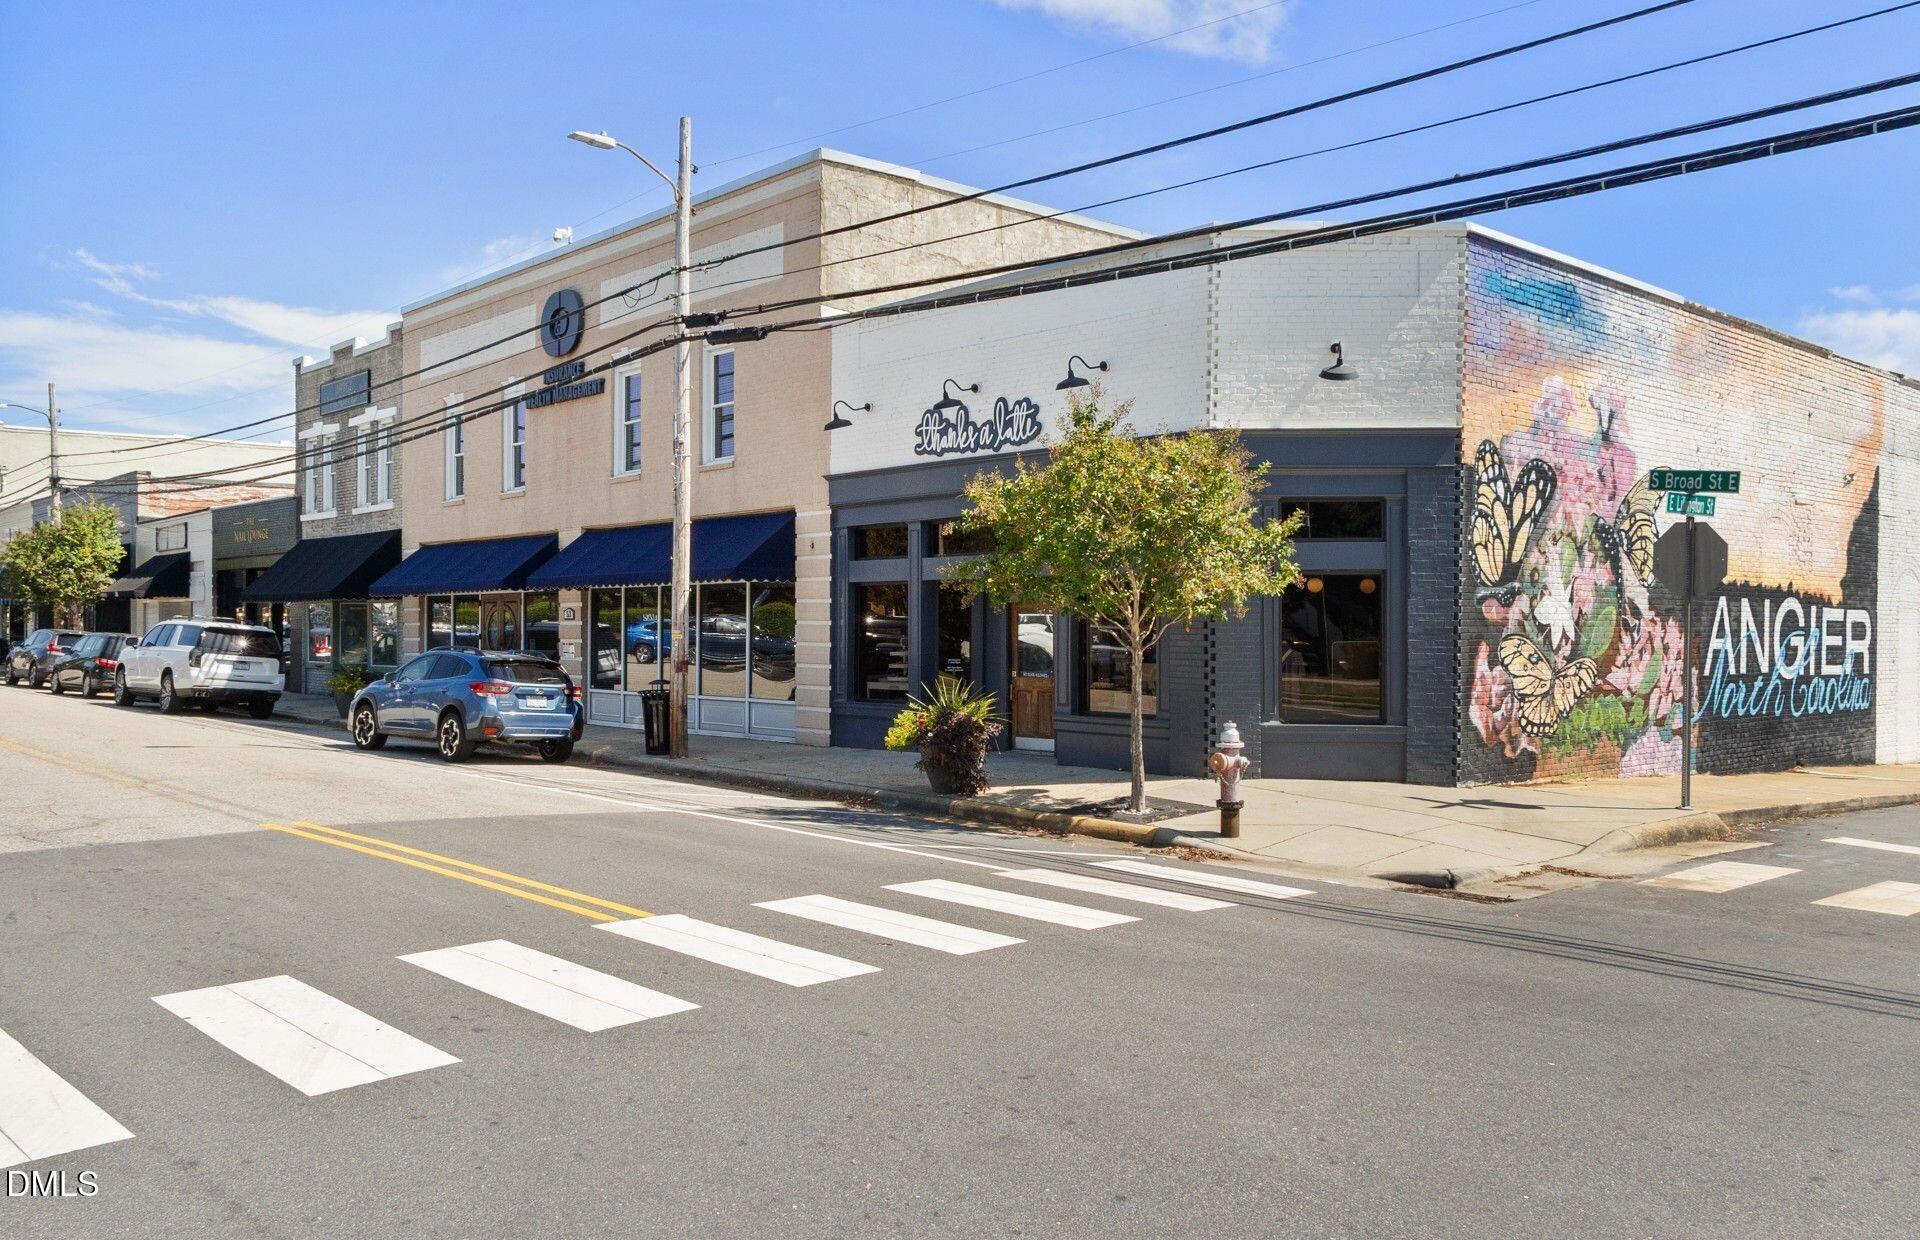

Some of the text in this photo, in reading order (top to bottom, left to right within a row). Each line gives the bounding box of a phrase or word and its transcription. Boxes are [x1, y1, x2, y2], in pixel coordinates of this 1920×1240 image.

[552, 378, 605, 403] MANAGEMENT
[917, 401, 1038, 452] thanks a latte
[1650, 472, 1738, 491] S Broad St E
[1669, 494, 1675, 511] E
[1706, 498, 1714, 514] St
[1703, 596, 1872, 680] ANGIER
[1691, 628, 1871, 723] North Carolina
